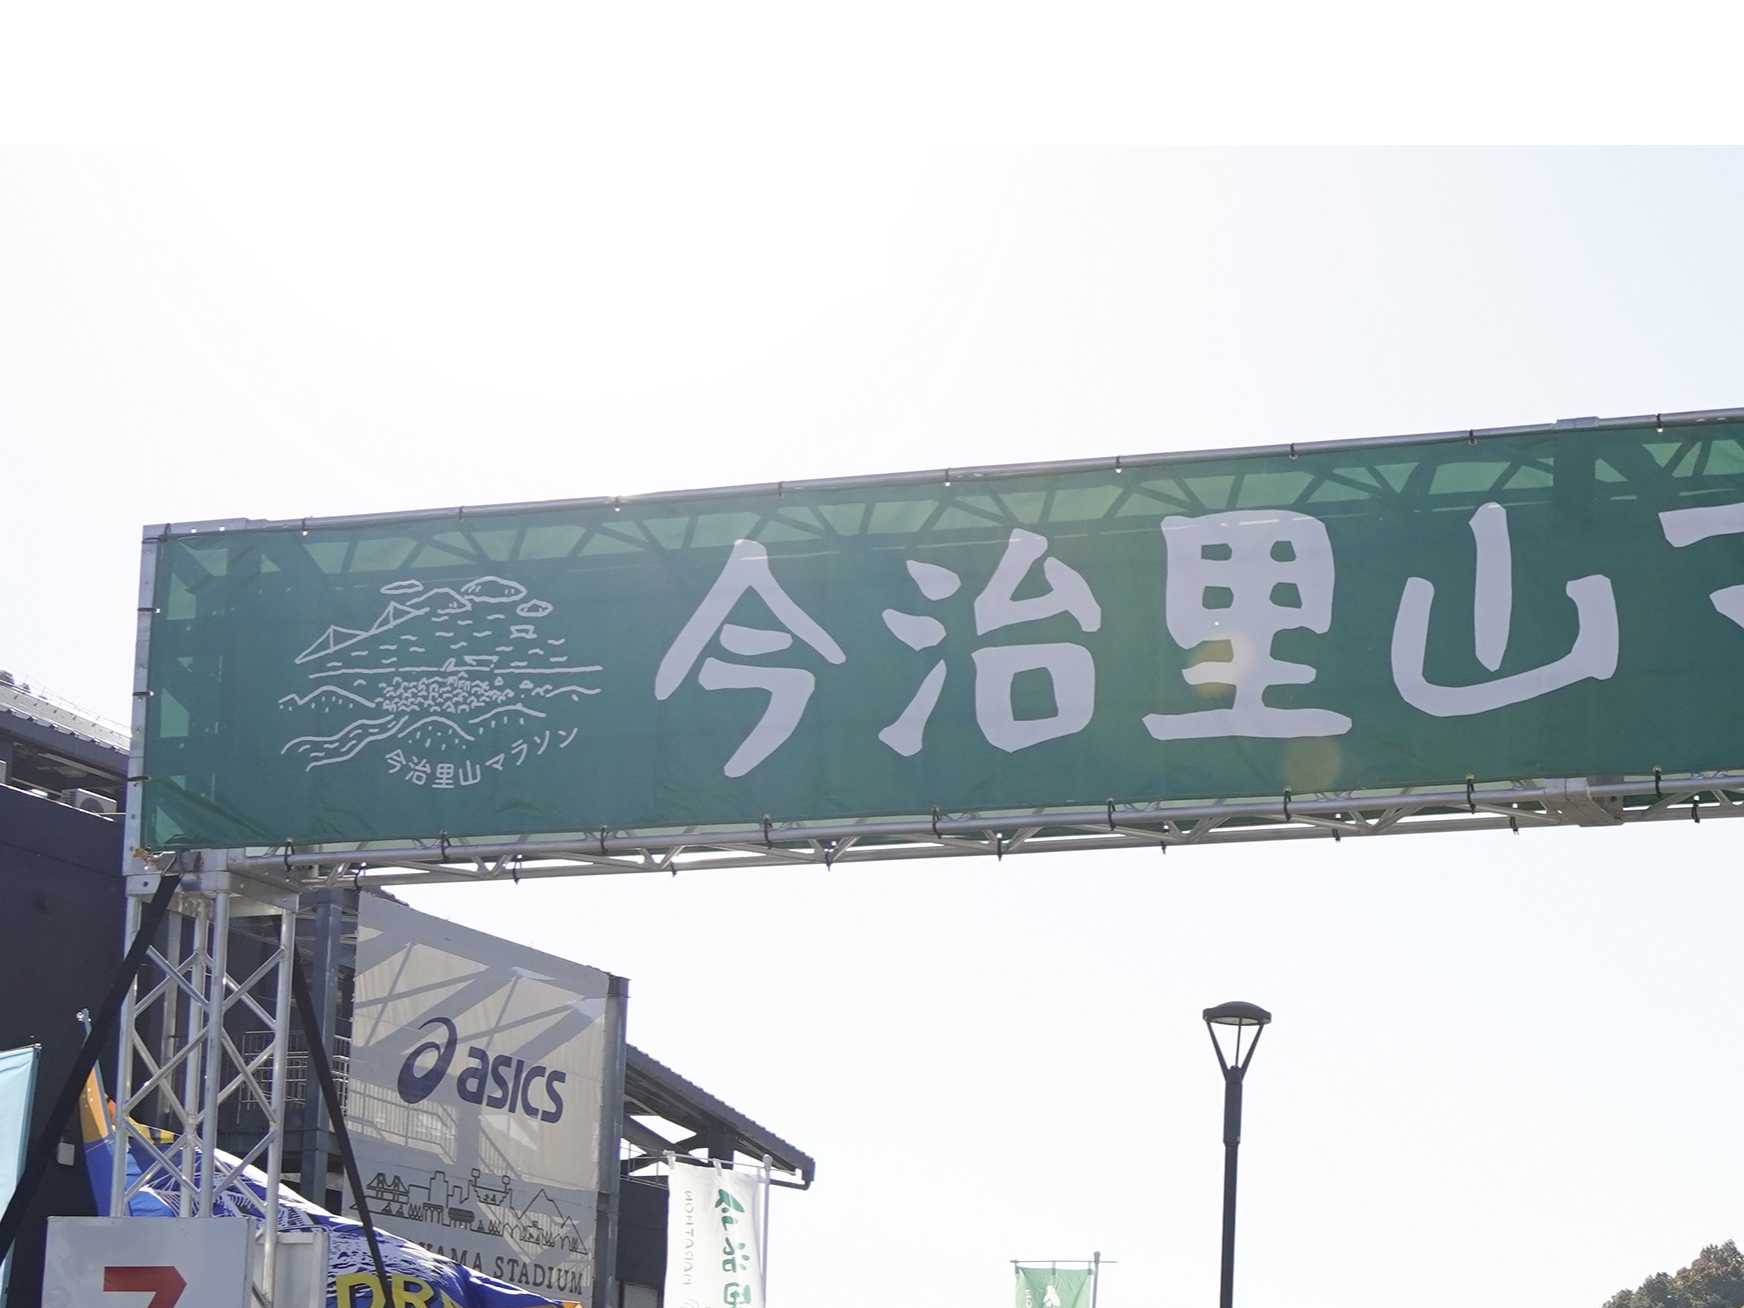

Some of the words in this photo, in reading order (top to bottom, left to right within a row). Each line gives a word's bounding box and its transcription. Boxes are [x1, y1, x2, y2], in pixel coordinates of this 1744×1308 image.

[385, 728, 577, 788] 今治里山マラソン
[493, 1256, 583, 1296] STADIUM
